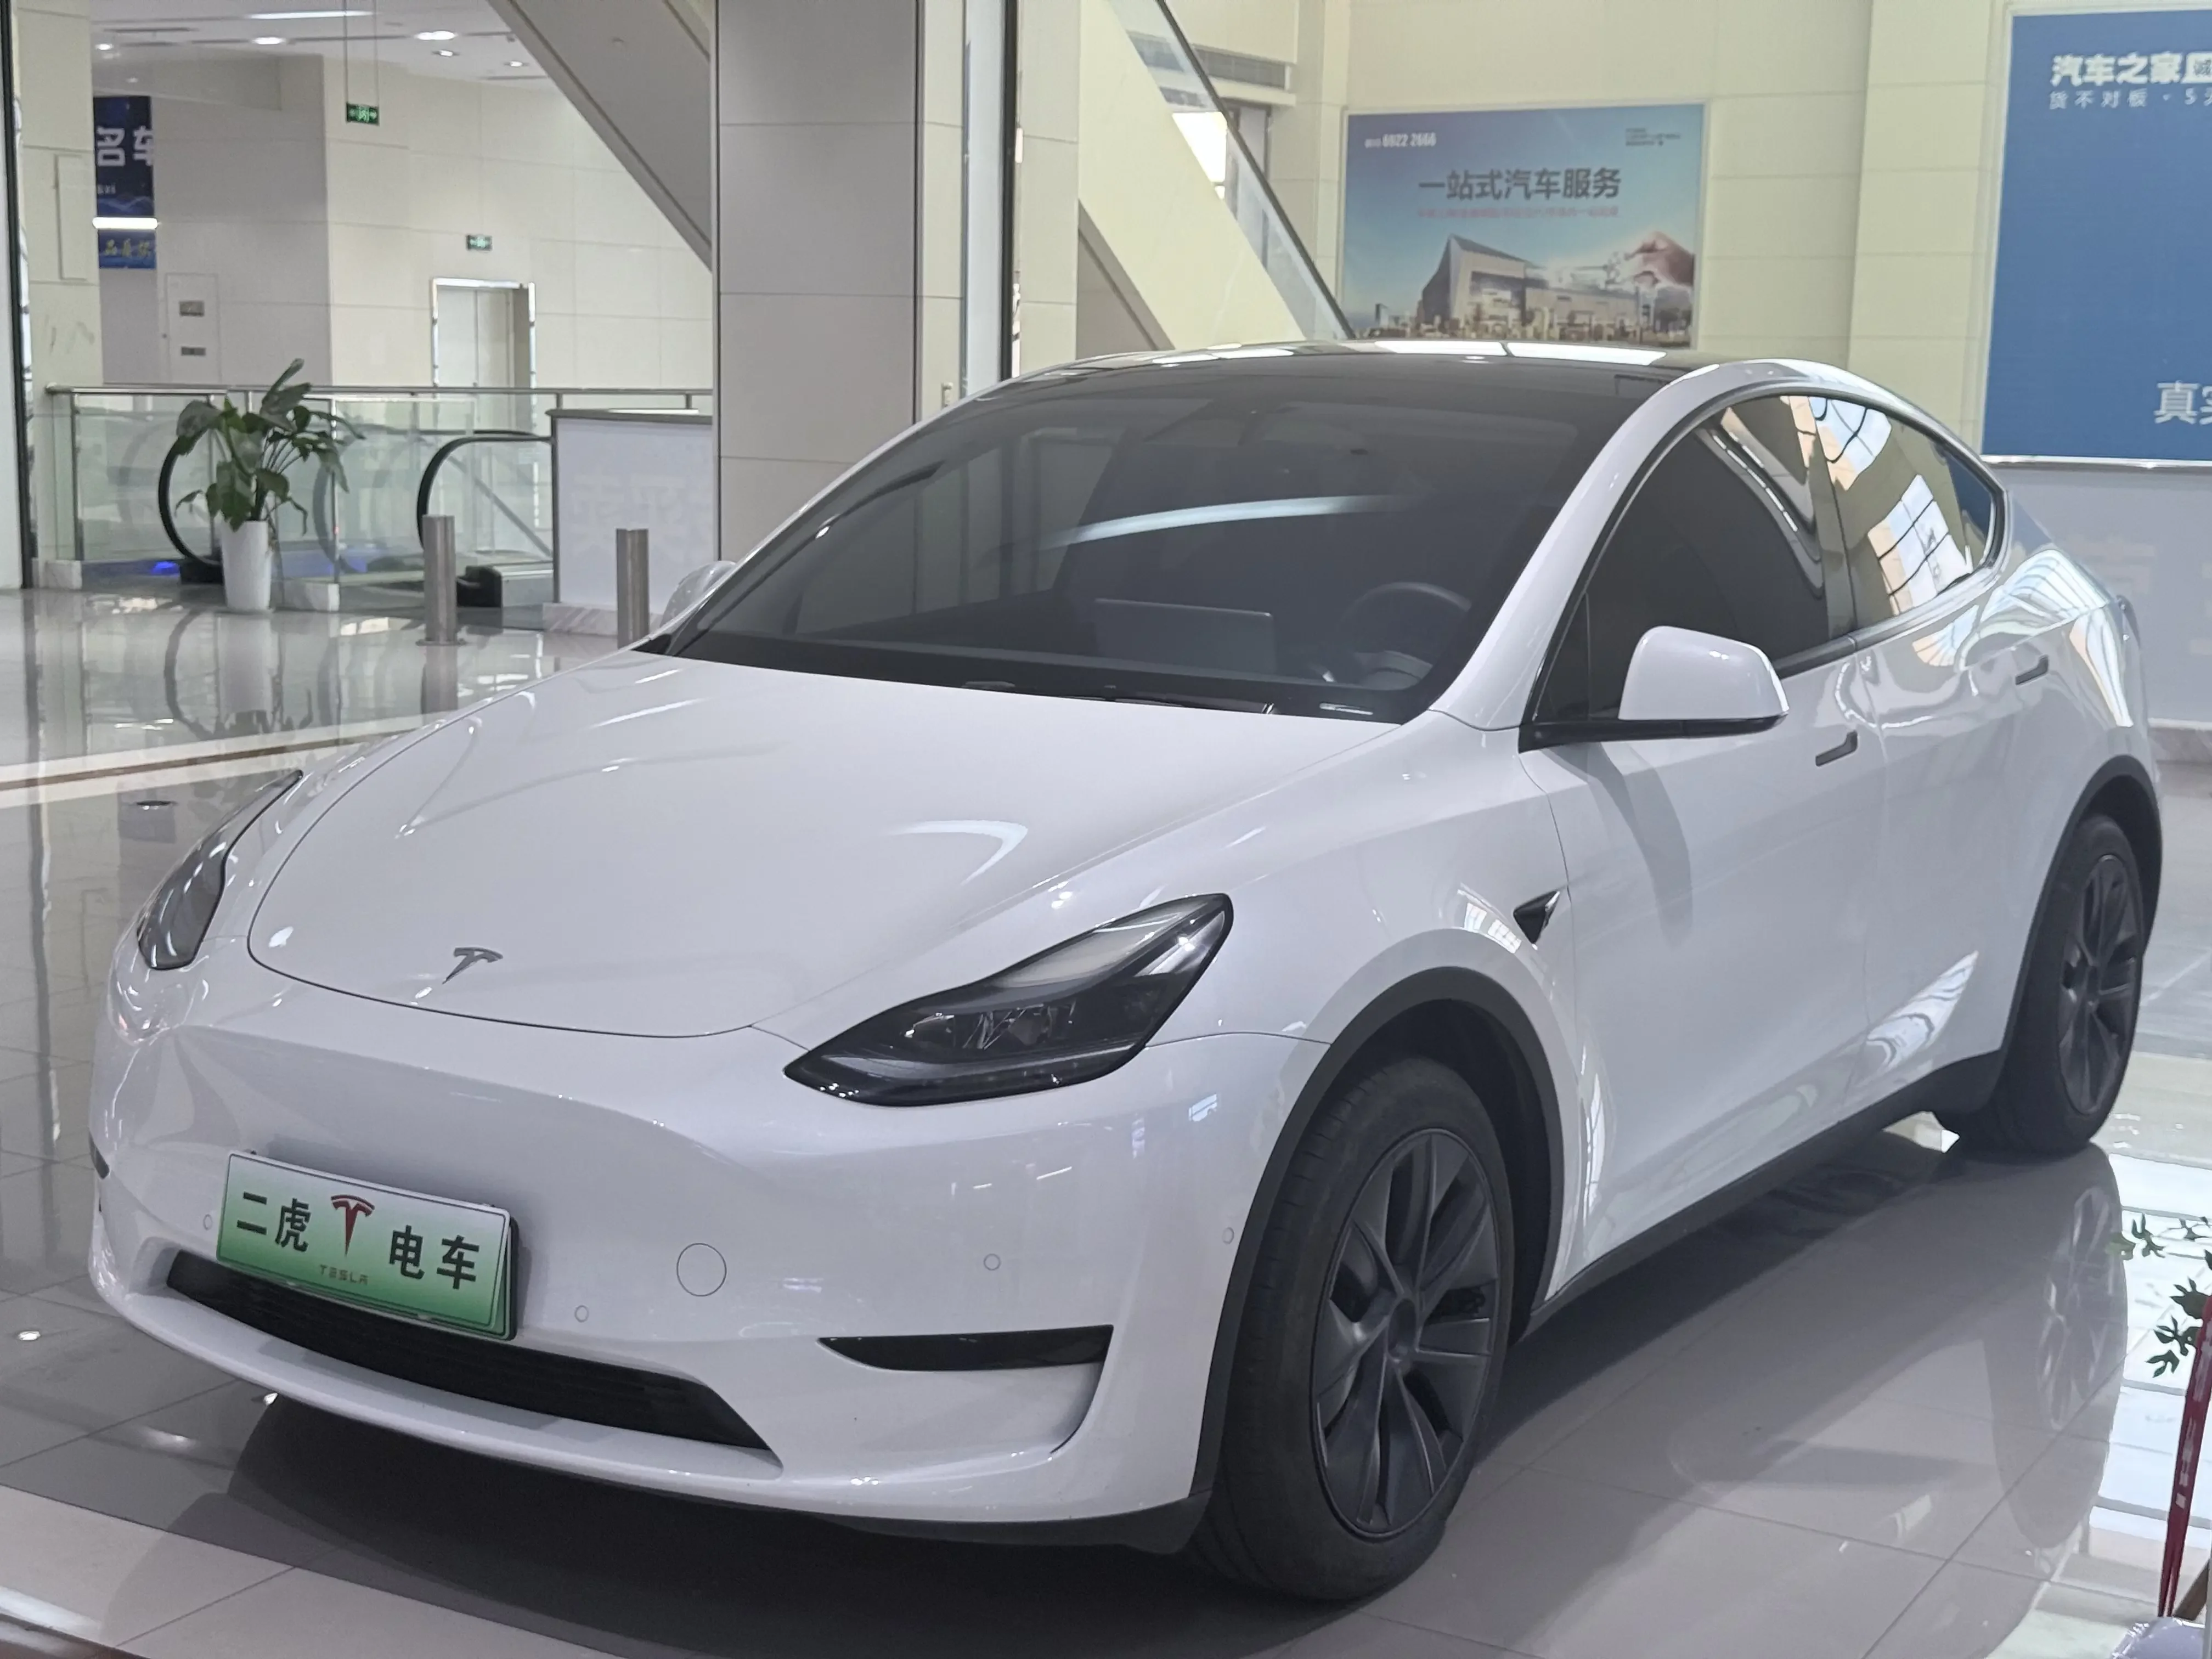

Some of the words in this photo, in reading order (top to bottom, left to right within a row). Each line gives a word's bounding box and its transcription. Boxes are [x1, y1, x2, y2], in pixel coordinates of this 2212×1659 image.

[2050, 51, 2183, 86] 汽车之家
[1419, 167, 1622, 201] 一站式汽车服务
[236, 1191, 312, 1252] 二虎
[389, 1224, 479, 1290] 电车
[320, 1263, 369, 1285] TESLA
